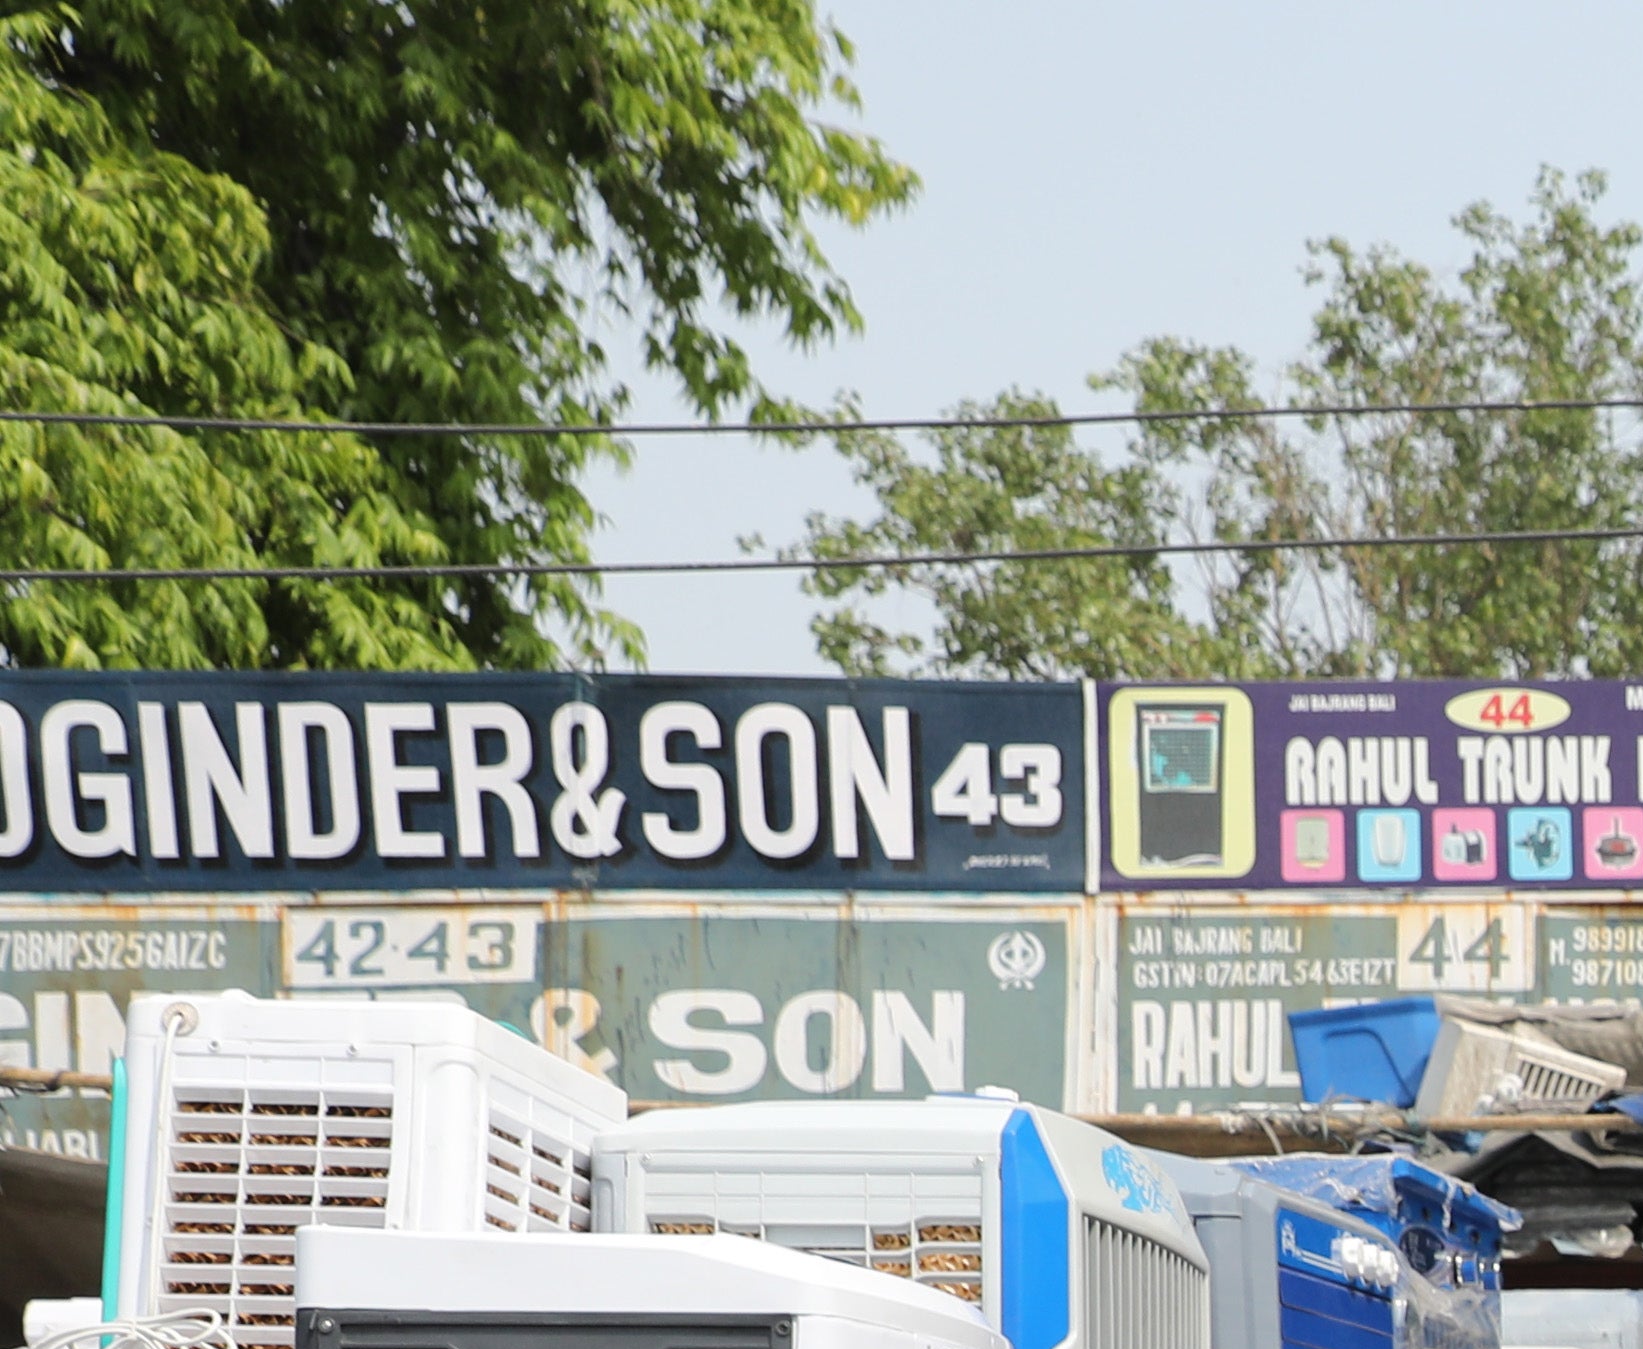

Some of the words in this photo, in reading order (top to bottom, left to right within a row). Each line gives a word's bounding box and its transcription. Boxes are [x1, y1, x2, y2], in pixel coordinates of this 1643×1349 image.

[1288, 695, 1308, 712] JAI
[1480, 693, 1534, 728] 44
[932, 743, 1062, 828] 43
[1285, 735, 1439, 805] RAHUL
[1457, 736, 1612, 804] TRUNK
[1129, 927, 1162, 954] JAI
[1172, 927, 1252, 955] BAJRANG
[1260, 926, 1303, 953] BALI
[1408, 916, 1511, 981] 44
[650, 988, 964, 1093] SON
[1132, 1000, 1299, 1089] RAHUL
